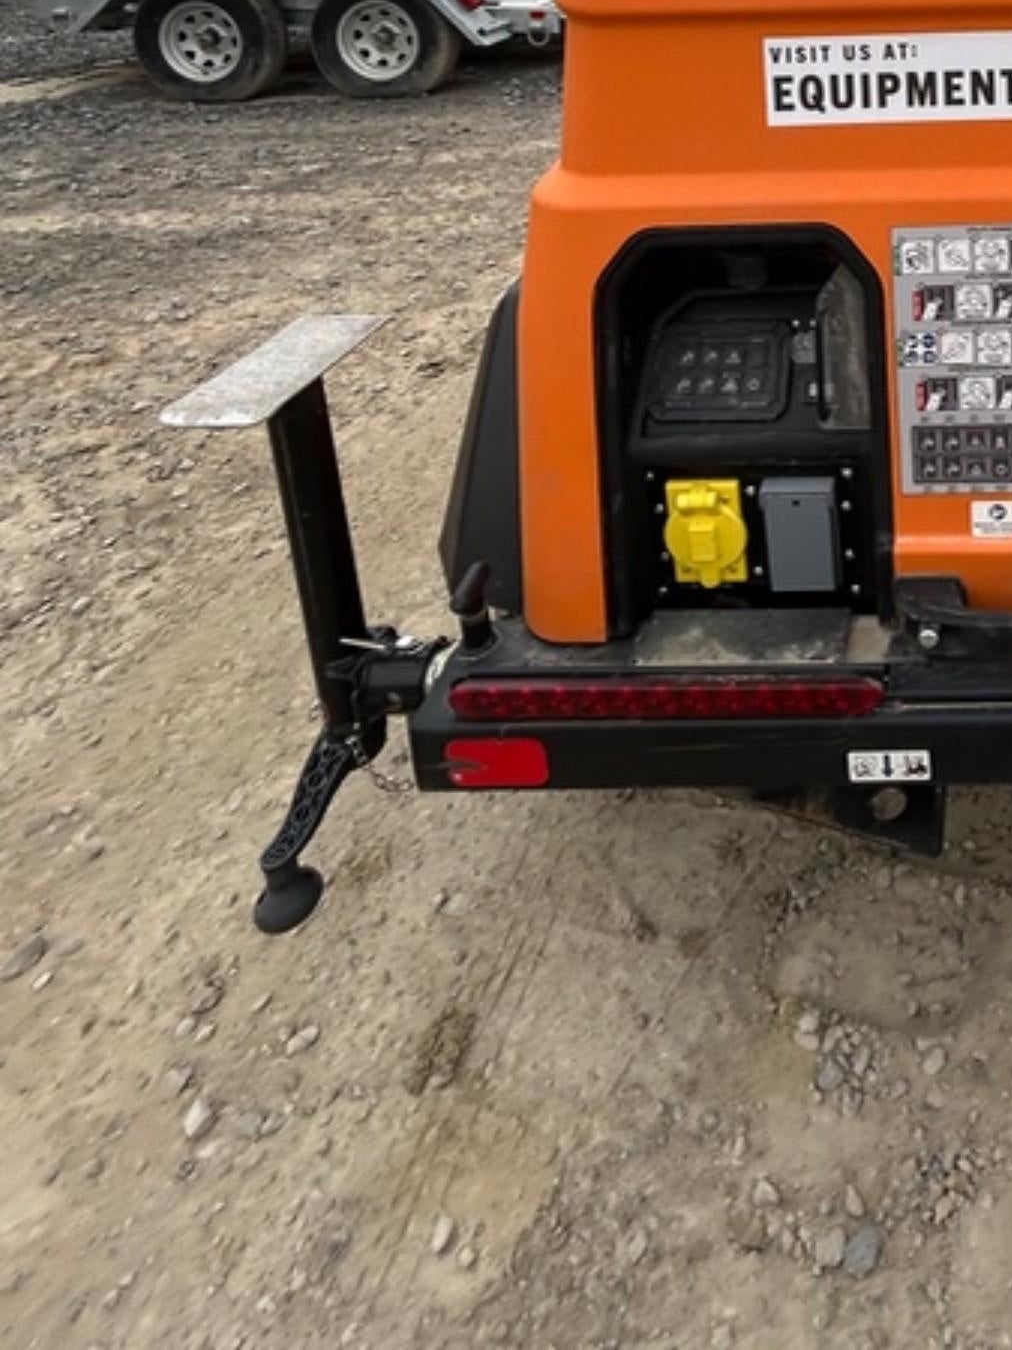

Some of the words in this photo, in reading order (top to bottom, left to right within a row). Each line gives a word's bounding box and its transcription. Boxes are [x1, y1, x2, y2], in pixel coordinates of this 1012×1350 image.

[768, 45, 830, 64] VISIT
[842, 43, 871, 61] US
[881, 41, 919, 61] AT:
